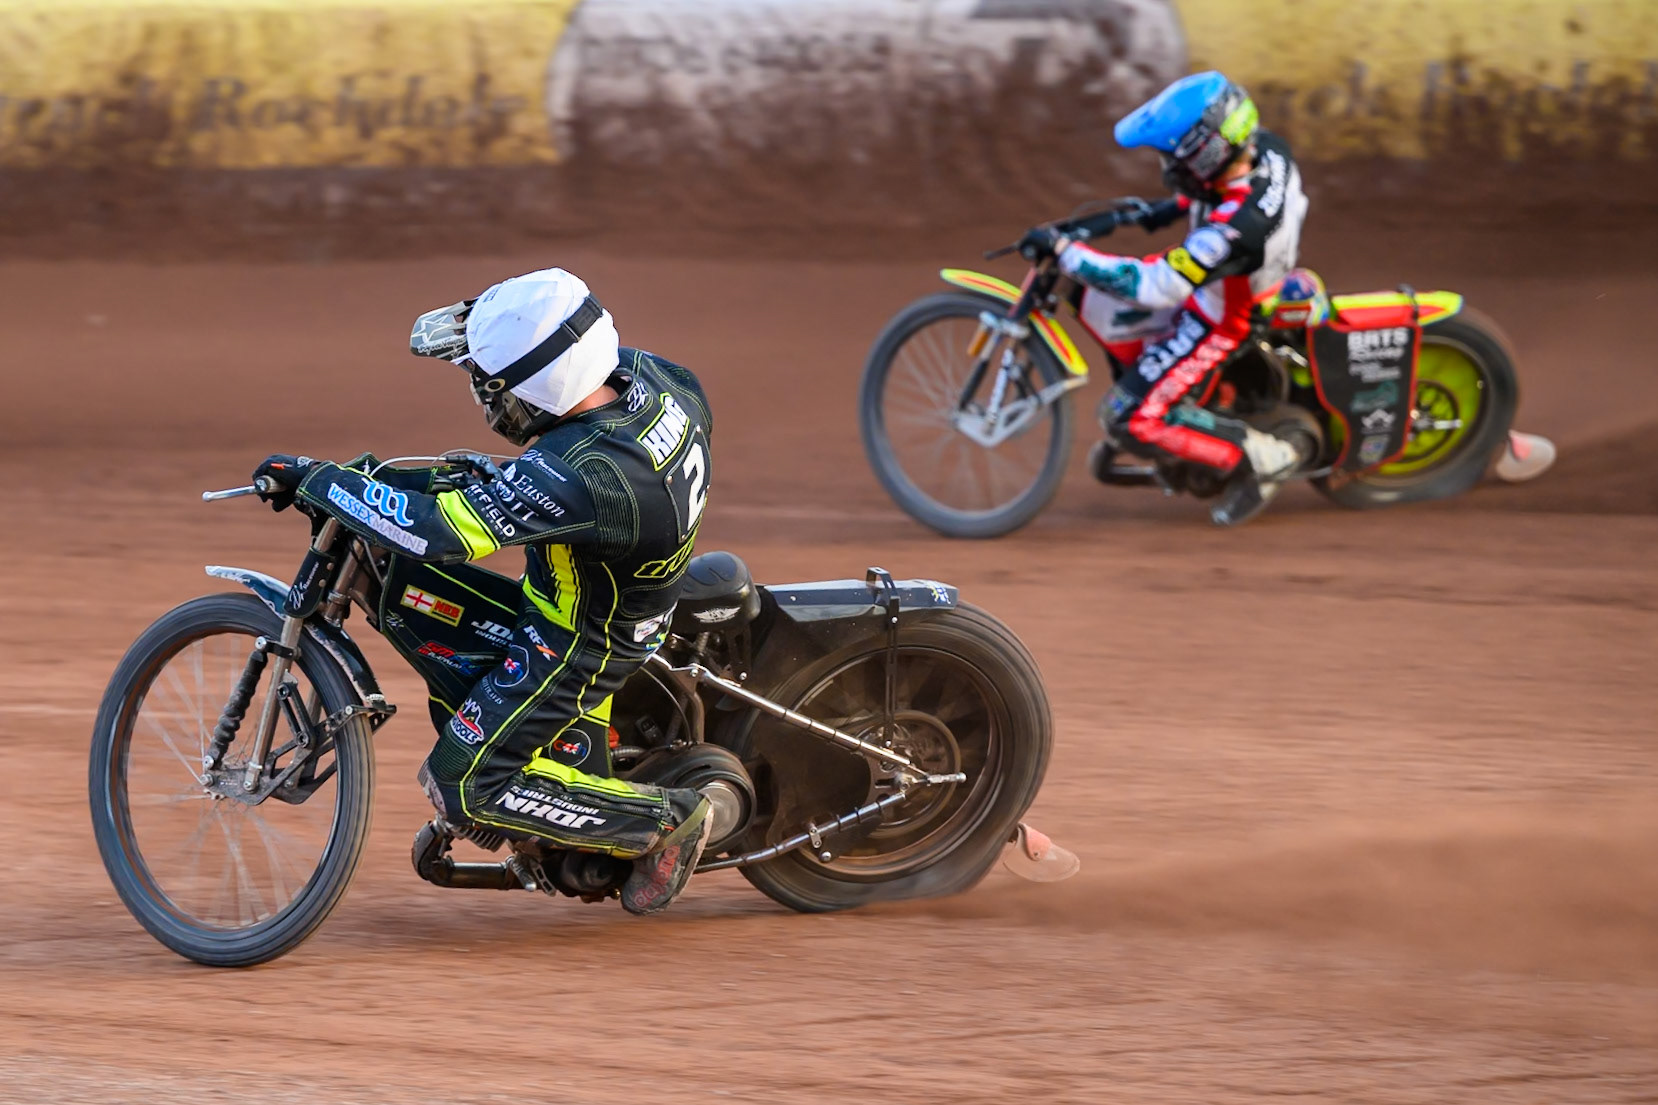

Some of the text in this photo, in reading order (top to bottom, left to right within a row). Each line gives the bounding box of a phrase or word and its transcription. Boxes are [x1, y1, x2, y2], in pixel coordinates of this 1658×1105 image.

[328, 485, 426, 555] WESSEX MARINE
[512, 473, 566, 518] Euston
[682, 441, 706, 532] 2
